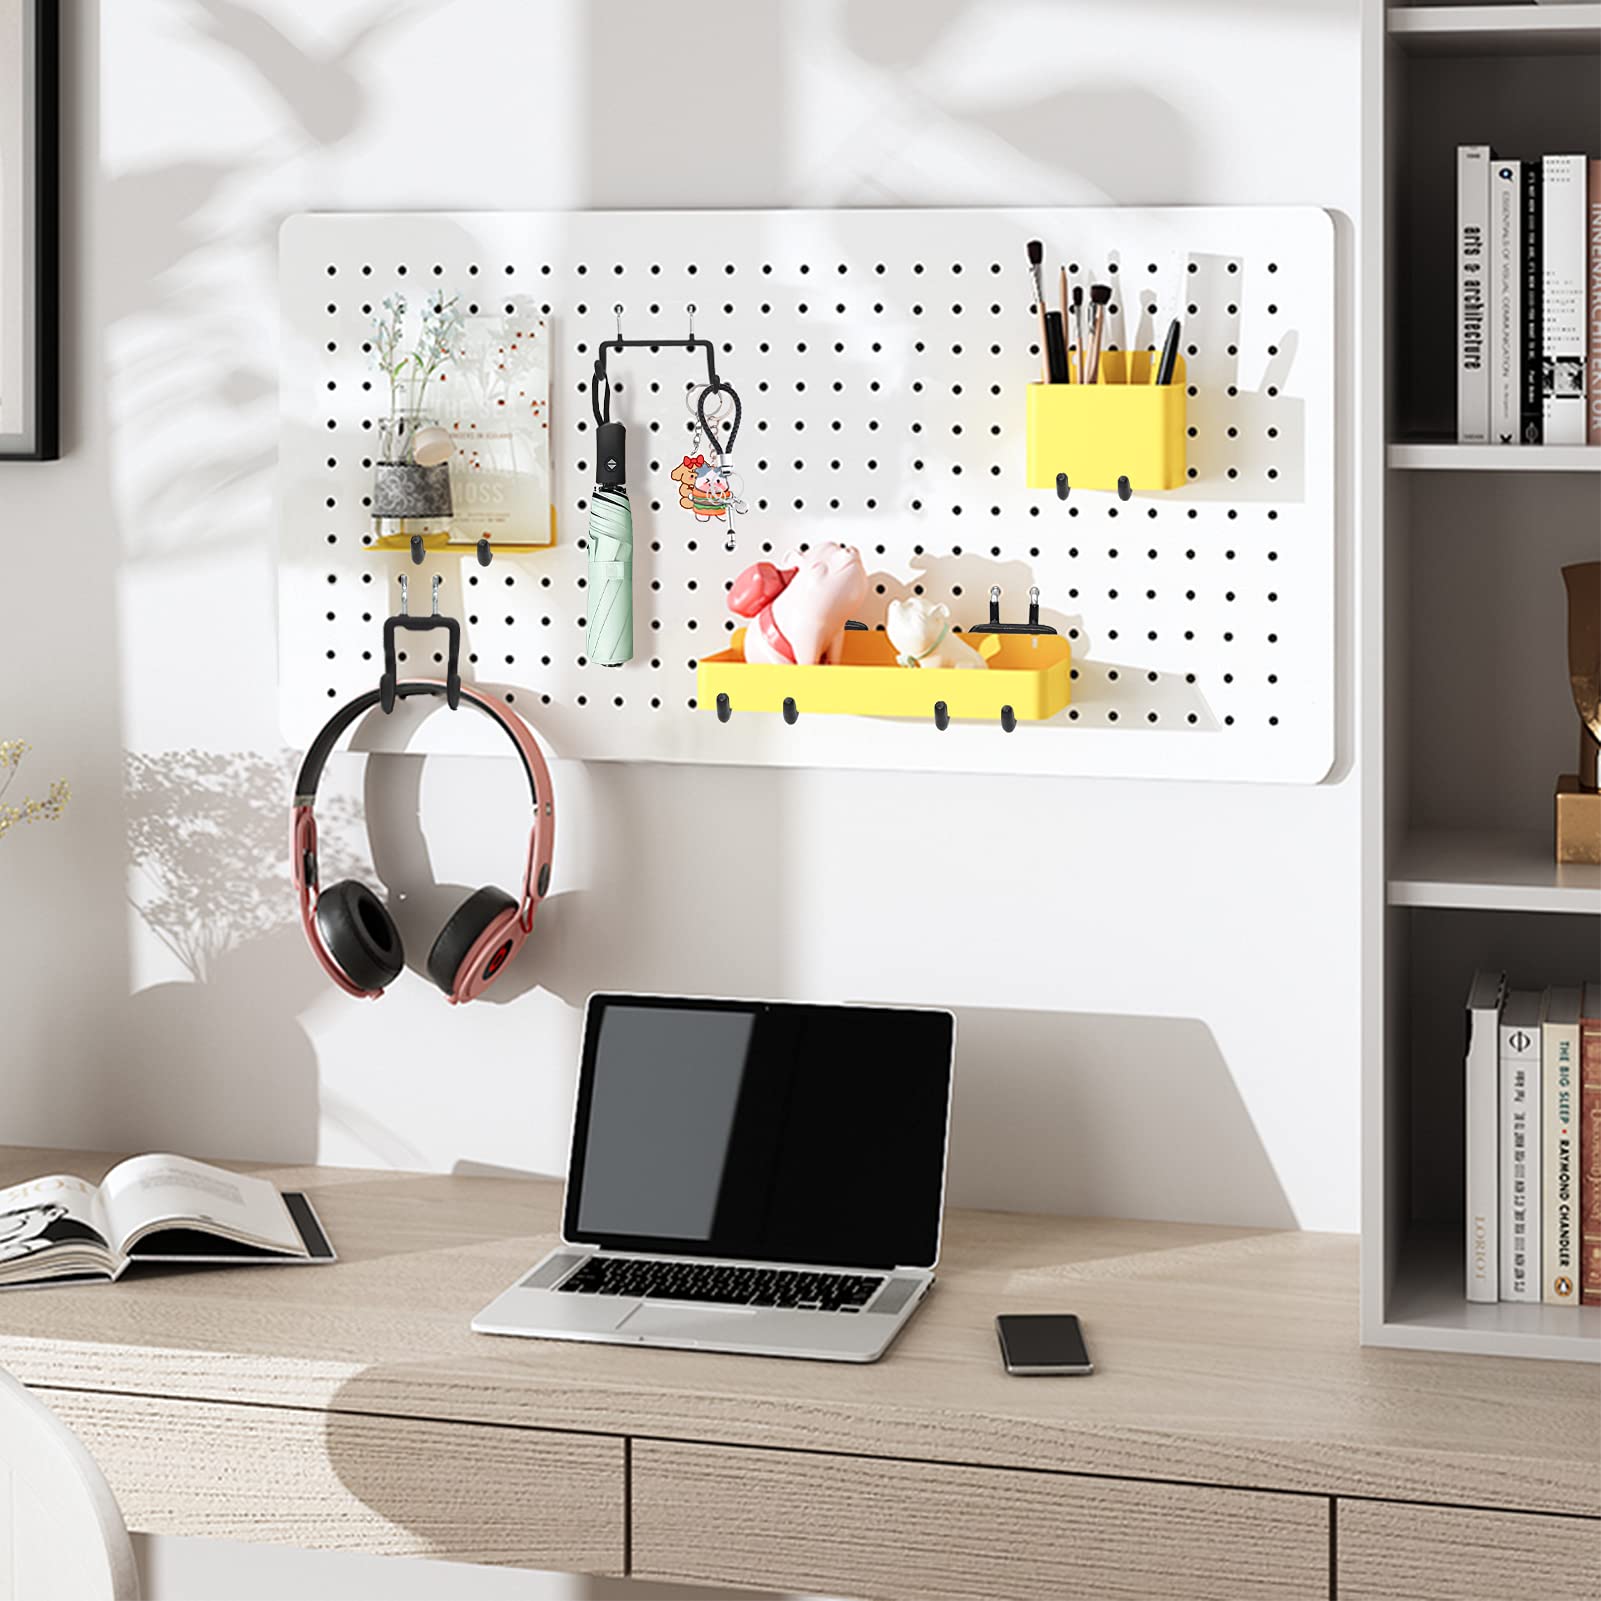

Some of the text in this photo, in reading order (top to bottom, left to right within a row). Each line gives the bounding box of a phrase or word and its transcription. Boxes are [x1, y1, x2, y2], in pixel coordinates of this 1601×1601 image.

[1464, 226, 1483, 256] arts
[1502, 191, 1511, 246] ESSENTIALS
[1502, 248, 1511, 259] OF
[1502, 263, 1511, 294] VISUAL
[1464, 280, 1484, 370] architecture
[1502, 297, 1511, 377] COMMUNICATION
[1559, 1040, 1570, 1267] THE BIG SLEEP RAYMOND CHANDLER
